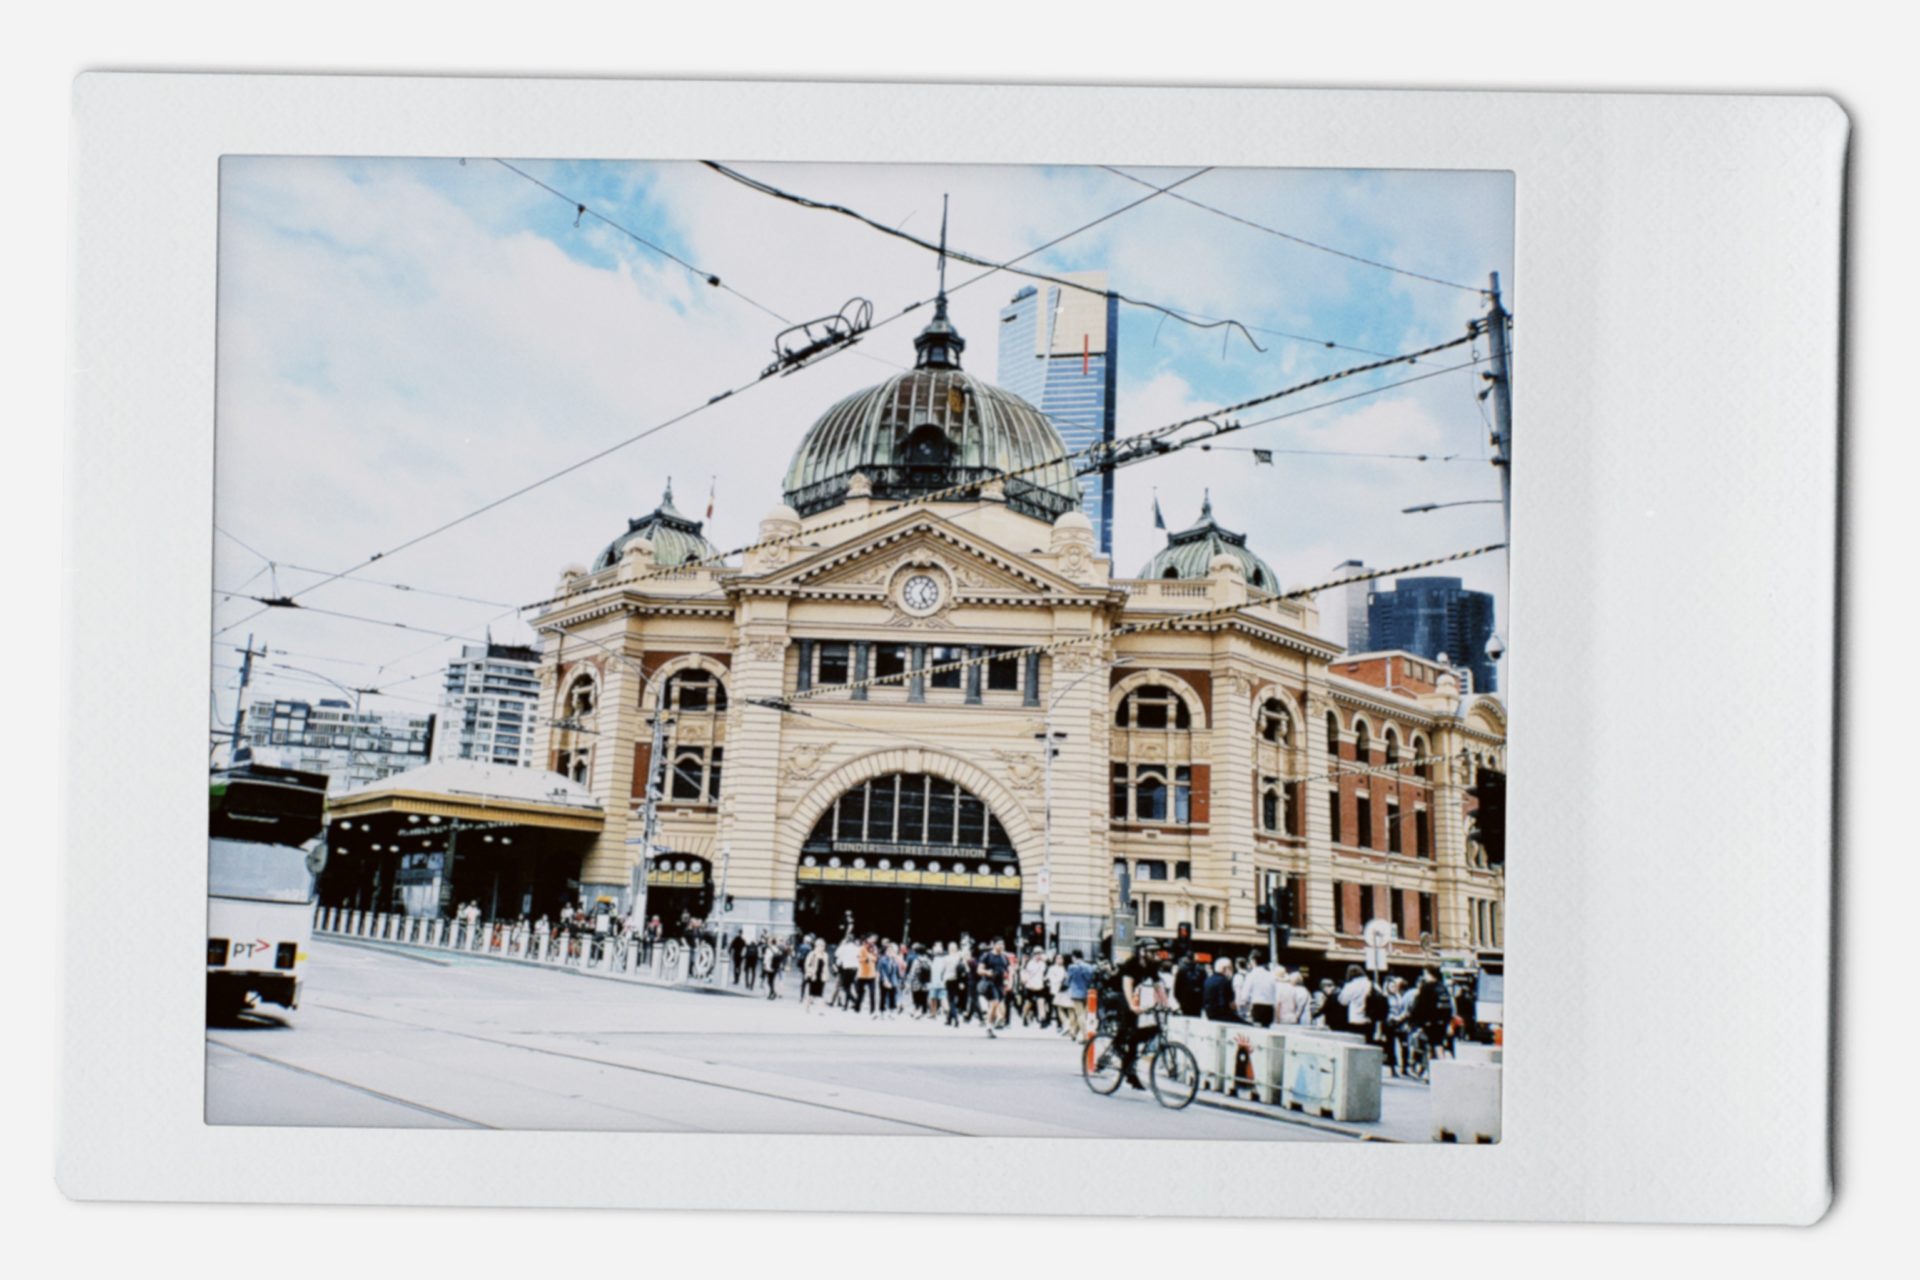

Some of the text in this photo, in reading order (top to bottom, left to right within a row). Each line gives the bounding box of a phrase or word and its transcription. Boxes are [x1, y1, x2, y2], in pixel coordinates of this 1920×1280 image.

[833, 842, 987, 858] FLINDERS STREET STATION
